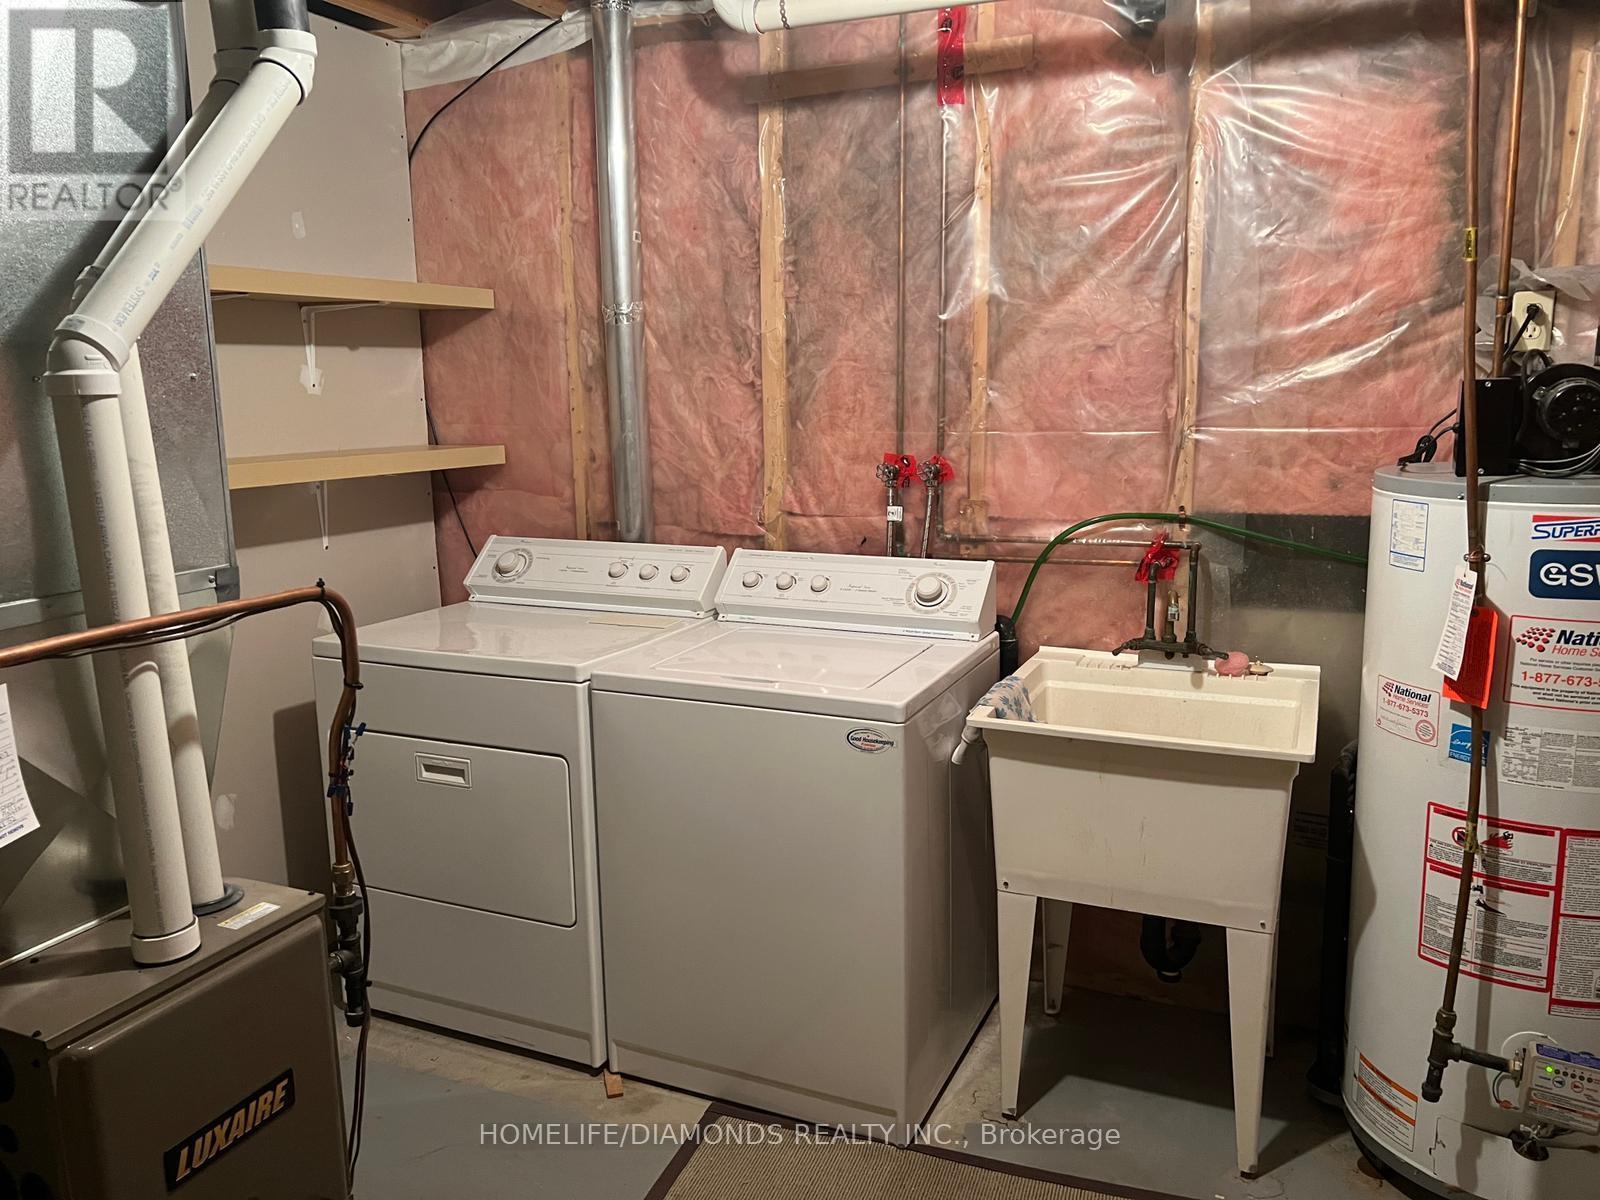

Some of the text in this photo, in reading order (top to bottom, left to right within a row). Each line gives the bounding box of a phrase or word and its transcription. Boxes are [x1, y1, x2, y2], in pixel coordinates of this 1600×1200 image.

[1540, 562, 1600, 587] GS
[1552, 645, 1588, 657] Home
[1394, 684, 1432, 703] National
[1383, 697, 1429, 718] 1-877-673-5373
[862, 737, 894, 747] Housekeeping
[176, 1078, 289, 1182] LUXAIRE
